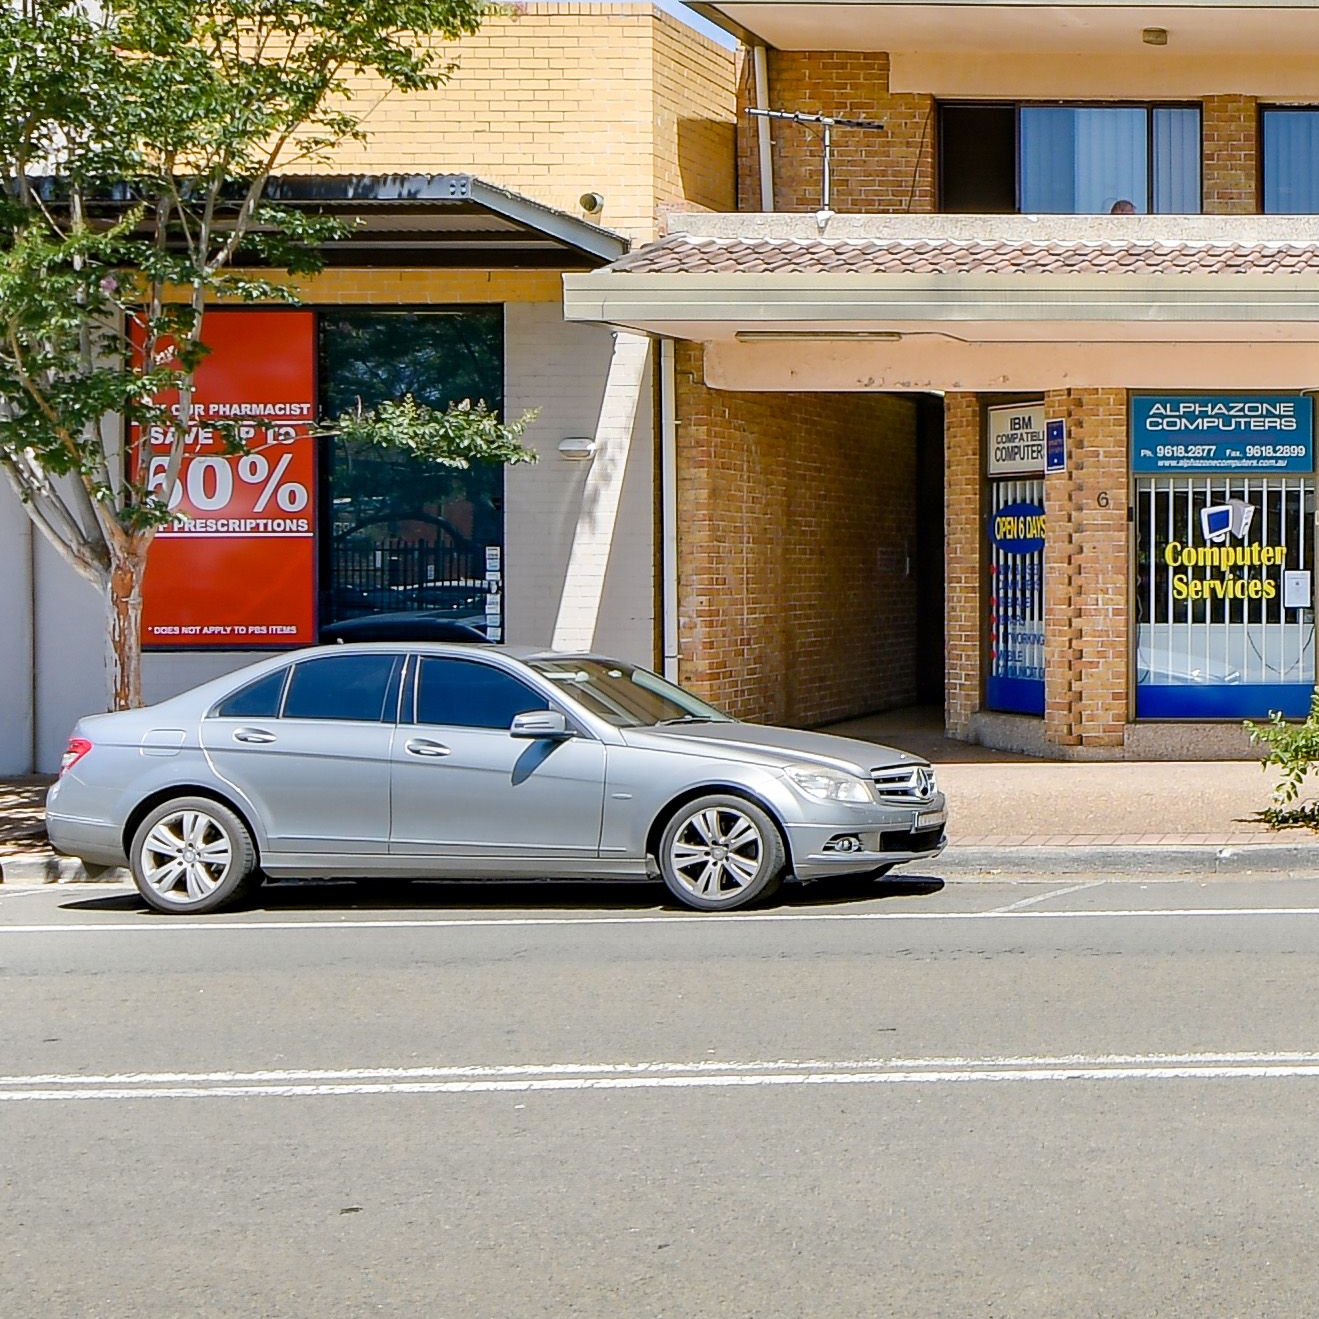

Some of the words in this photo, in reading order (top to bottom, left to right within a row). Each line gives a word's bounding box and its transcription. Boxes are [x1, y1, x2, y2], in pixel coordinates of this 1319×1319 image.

[209, 403, 311, 416] PHARMACIST
[1149, 402, 1295, 416] ALPHAZONE
[1010, 416, 1033, 431] IBM
[1145, 417, 1297, 431] COMPUTERS
[150, 426, 213, 445] SAVE
[1156, 445, 1217, 458] 9618.2877
[1245, 445, 1306, 458] 9618.2899
[1096, 492, 1109, 508] 6
[173, 519, 308, 531] PRESCRIPTIONS
[995, 516, 1017, 540] OPEN
[1018, 515, 1025, 540] 6
[1165, 541, 1287, 572] Computer
[1172, 573, 1276, 599] Services
[202, 626, 232, 634] APPLY
[233, 626, 246, 634] TO
[268, 626, 297, 634] ITEMS
